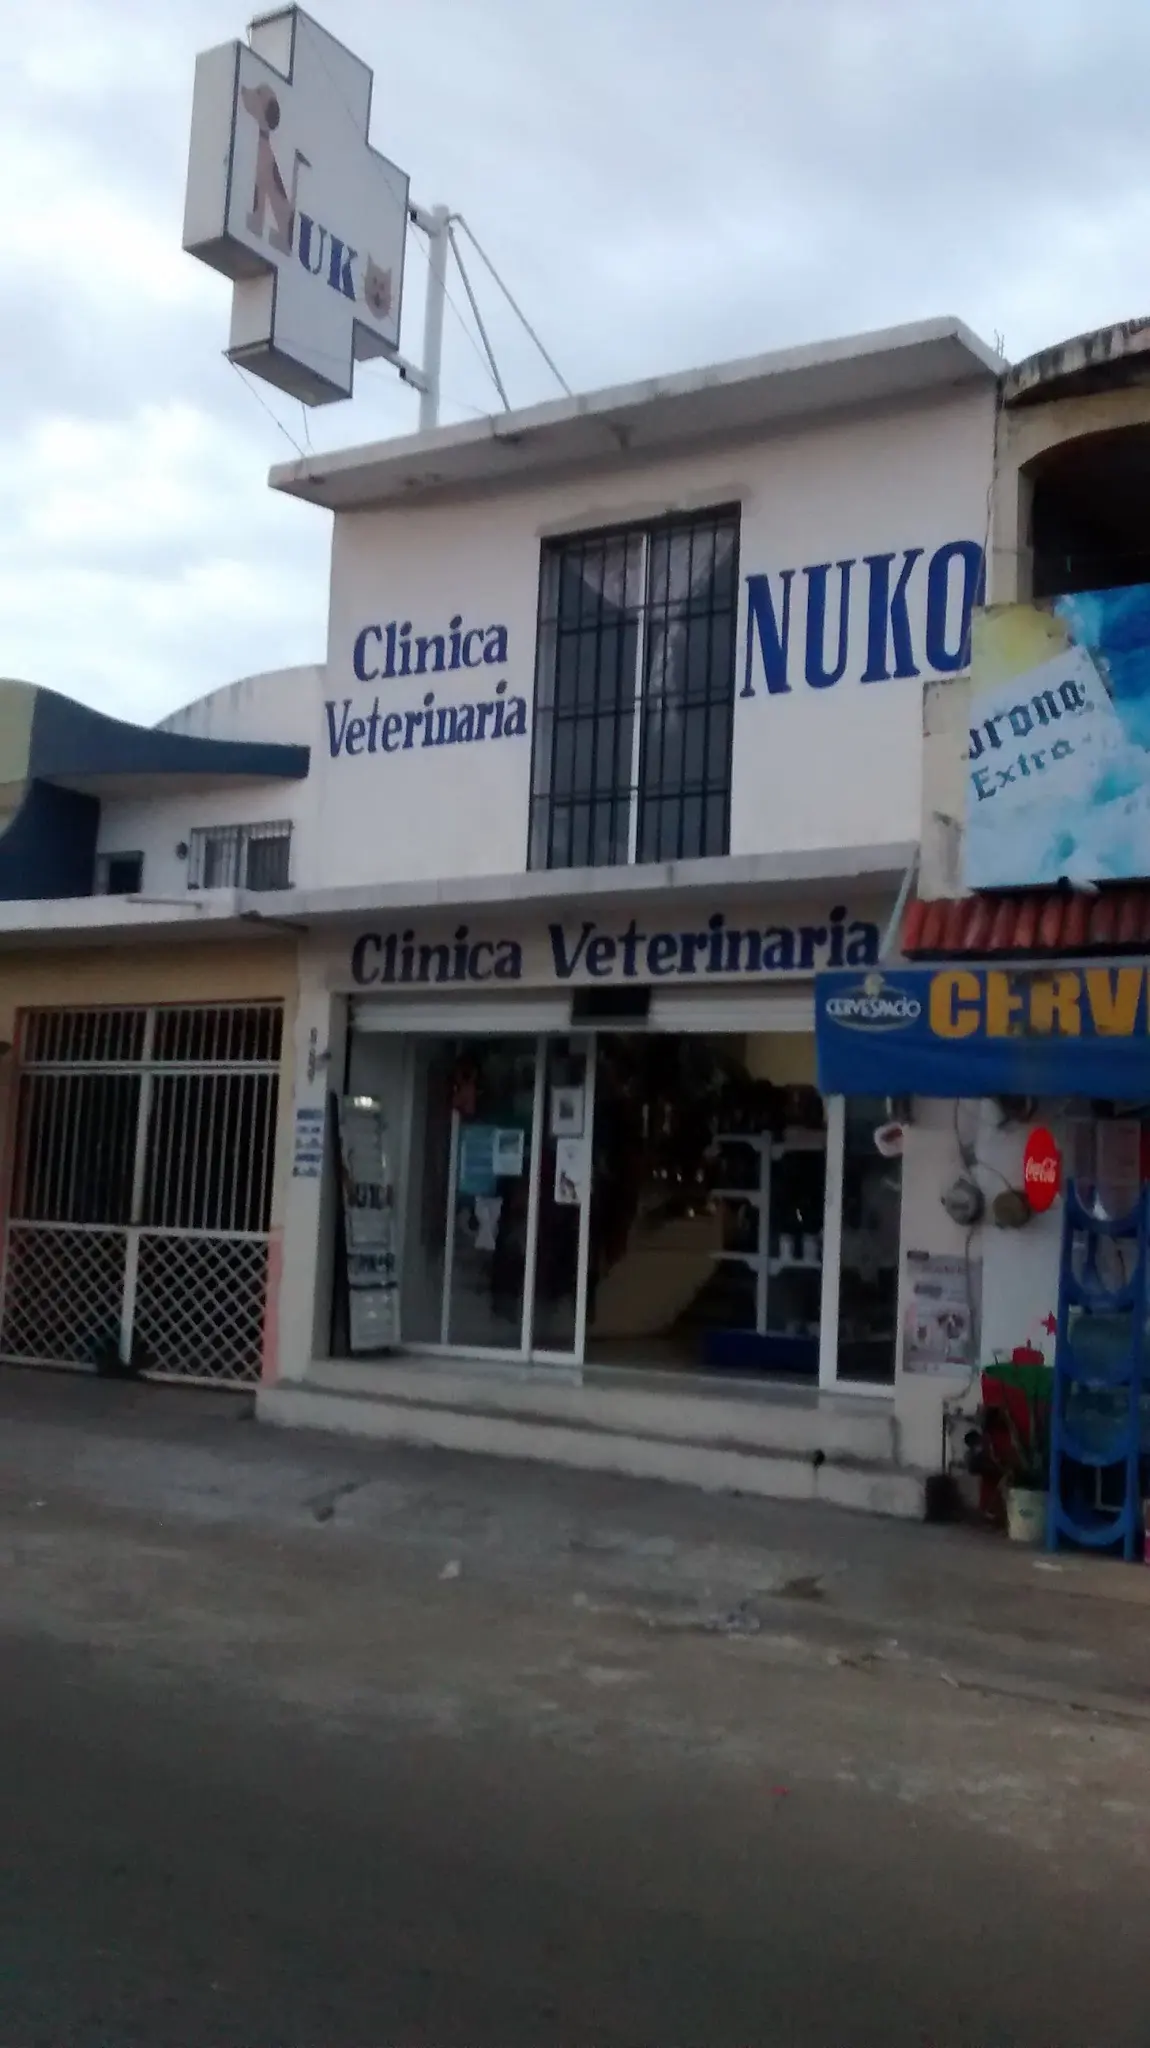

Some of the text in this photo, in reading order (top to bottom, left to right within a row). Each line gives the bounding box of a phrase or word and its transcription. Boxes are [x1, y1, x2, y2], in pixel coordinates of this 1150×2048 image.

[353, 614, 508, 681] Clinica
[740, 541, 985, 697] NUKO
[326, 679, 527, 757] Veterinaria
[971, 739, 1075, 800] Extra
[352, 905, 879, 984] Clinica Veterinaria
[930, 967, 1150, 1039] CERV
